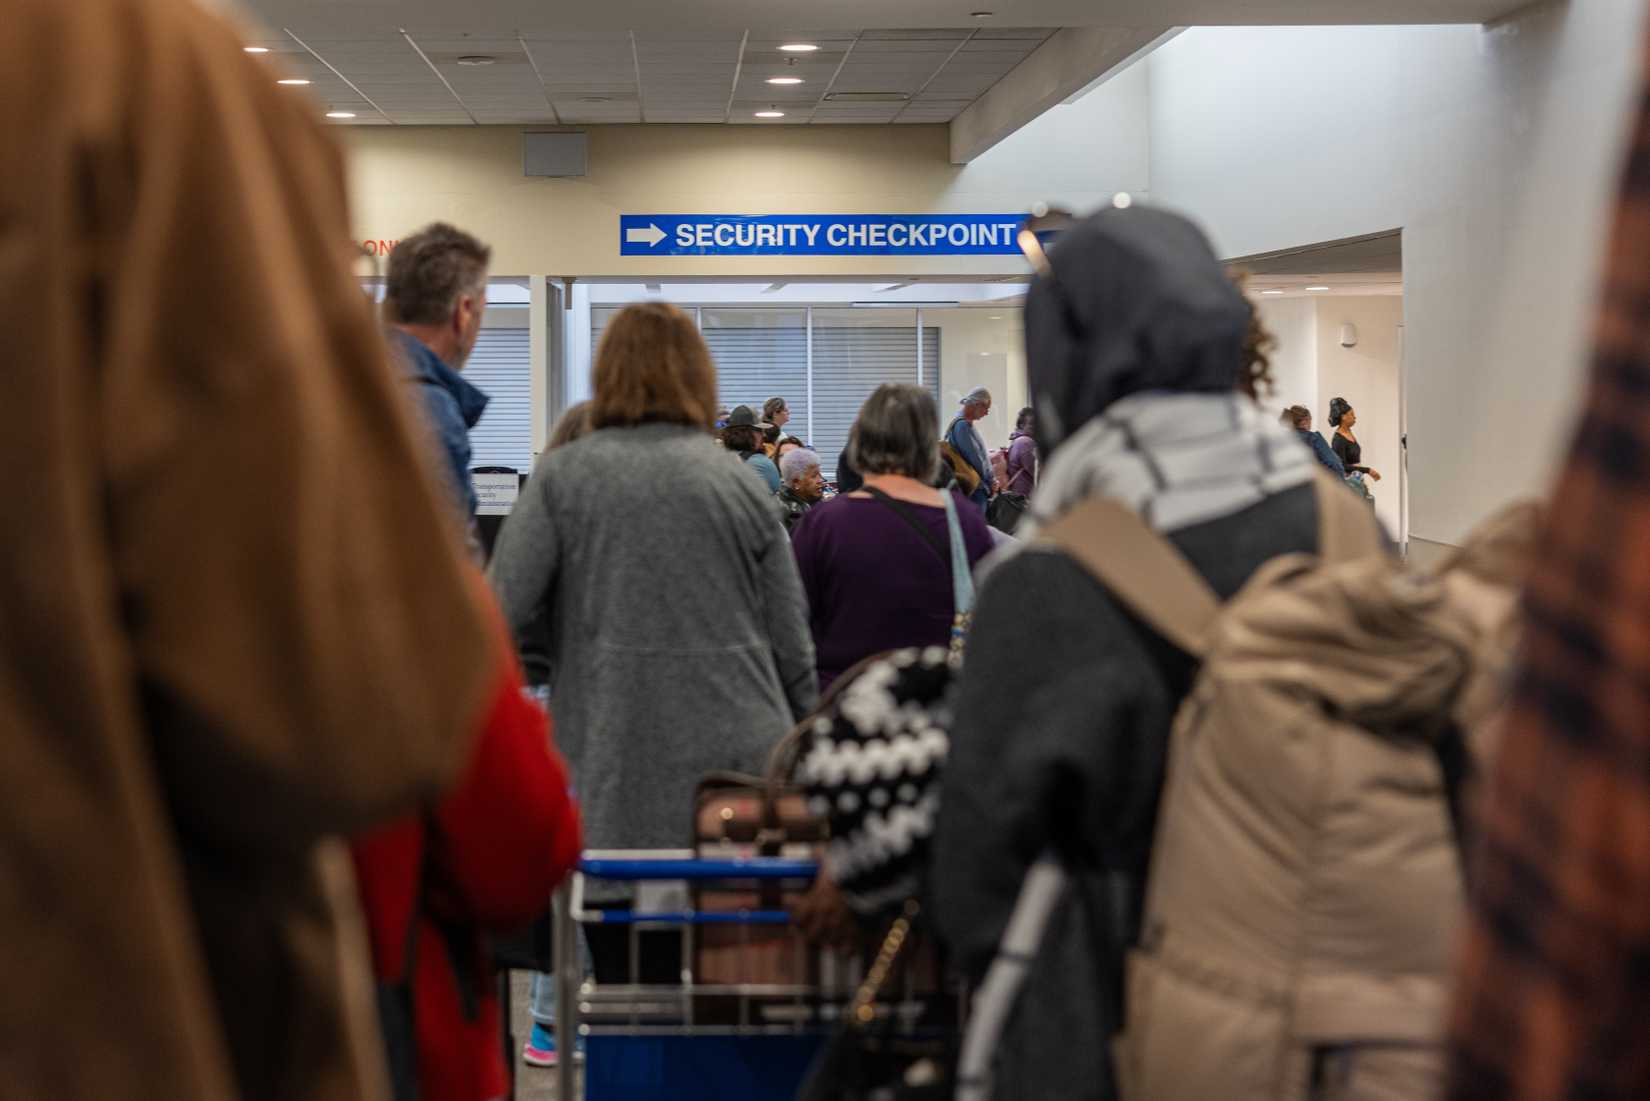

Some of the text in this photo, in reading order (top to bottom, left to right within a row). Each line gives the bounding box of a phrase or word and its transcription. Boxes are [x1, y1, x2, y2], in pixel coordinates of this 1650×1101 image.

[676, 223, 1016, 247] SECURITY CHECKPOINT
[363, 240, 400, 256] ON
